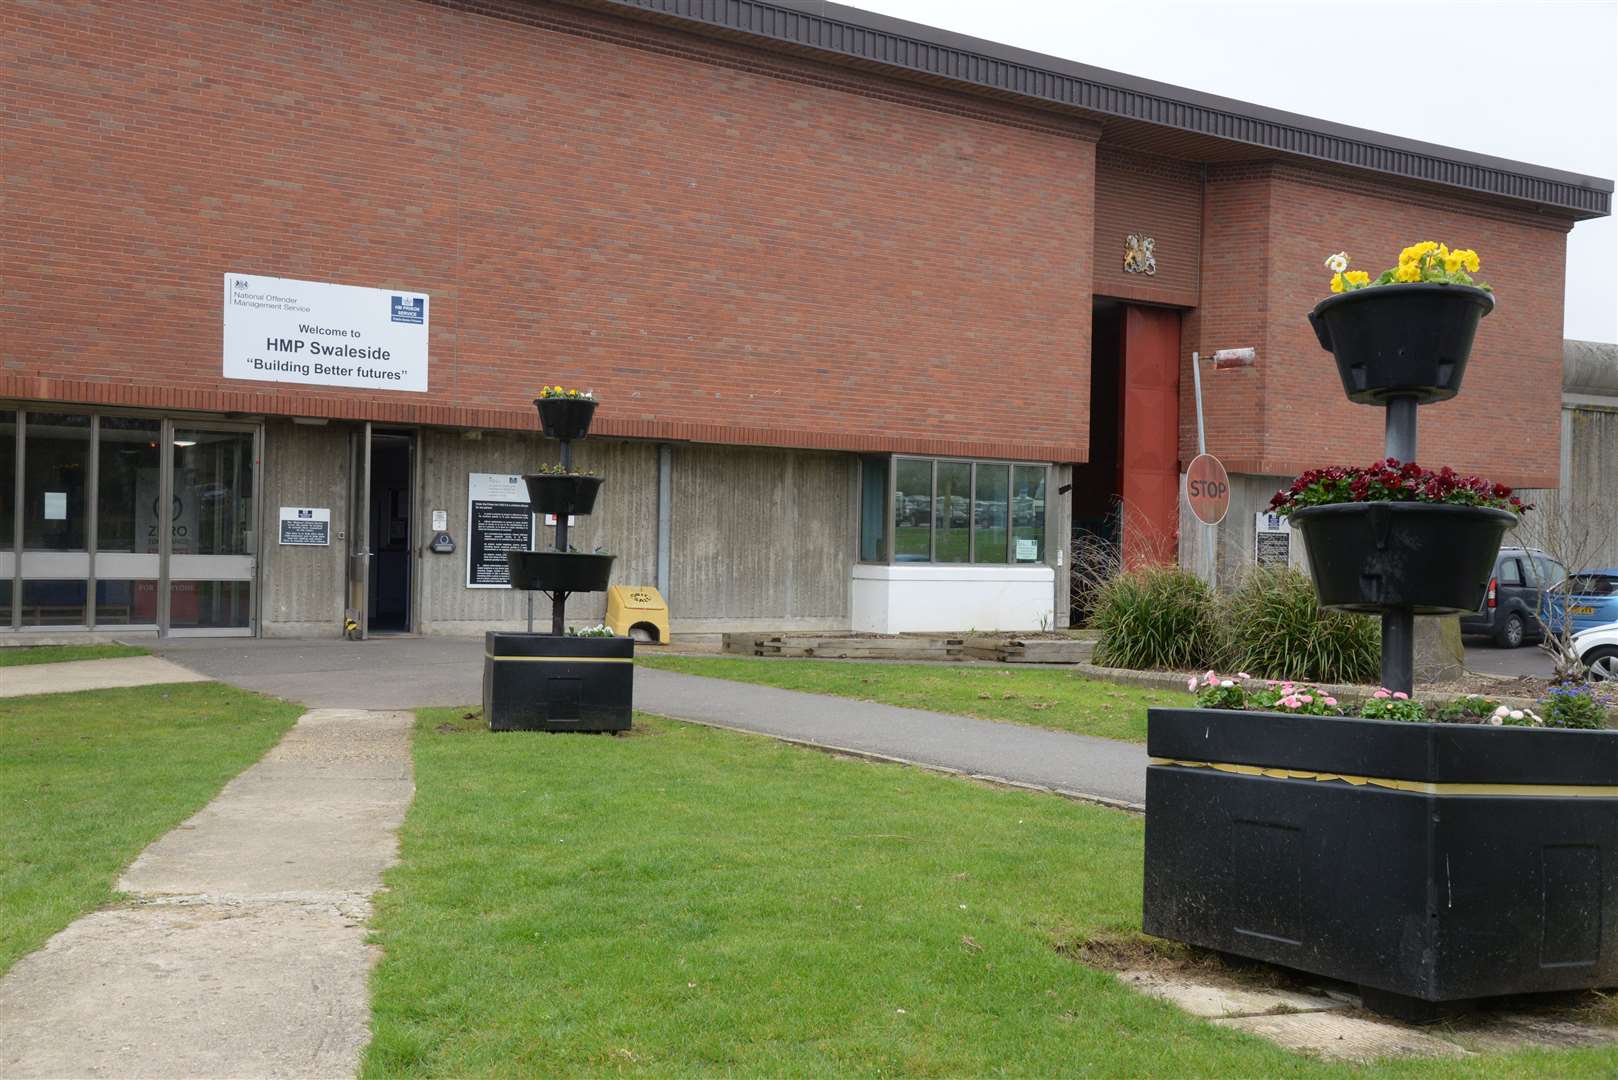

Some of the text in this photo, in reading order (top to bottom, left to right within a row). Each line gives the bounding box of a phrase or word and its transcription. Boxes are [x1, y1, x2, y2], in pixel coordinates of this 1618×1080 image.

[233, 291, 297, 304] National Offender
[233, 299, 311, 313] Management Service
[299, 324, 361, 338] Welcome to
[266, 337, 391, 361] HMP Swaleside
[314, 363, 353, 377] Better
[1190, 480, 1226, 498] STOP
[148, 525, 188, 537] ZRO
